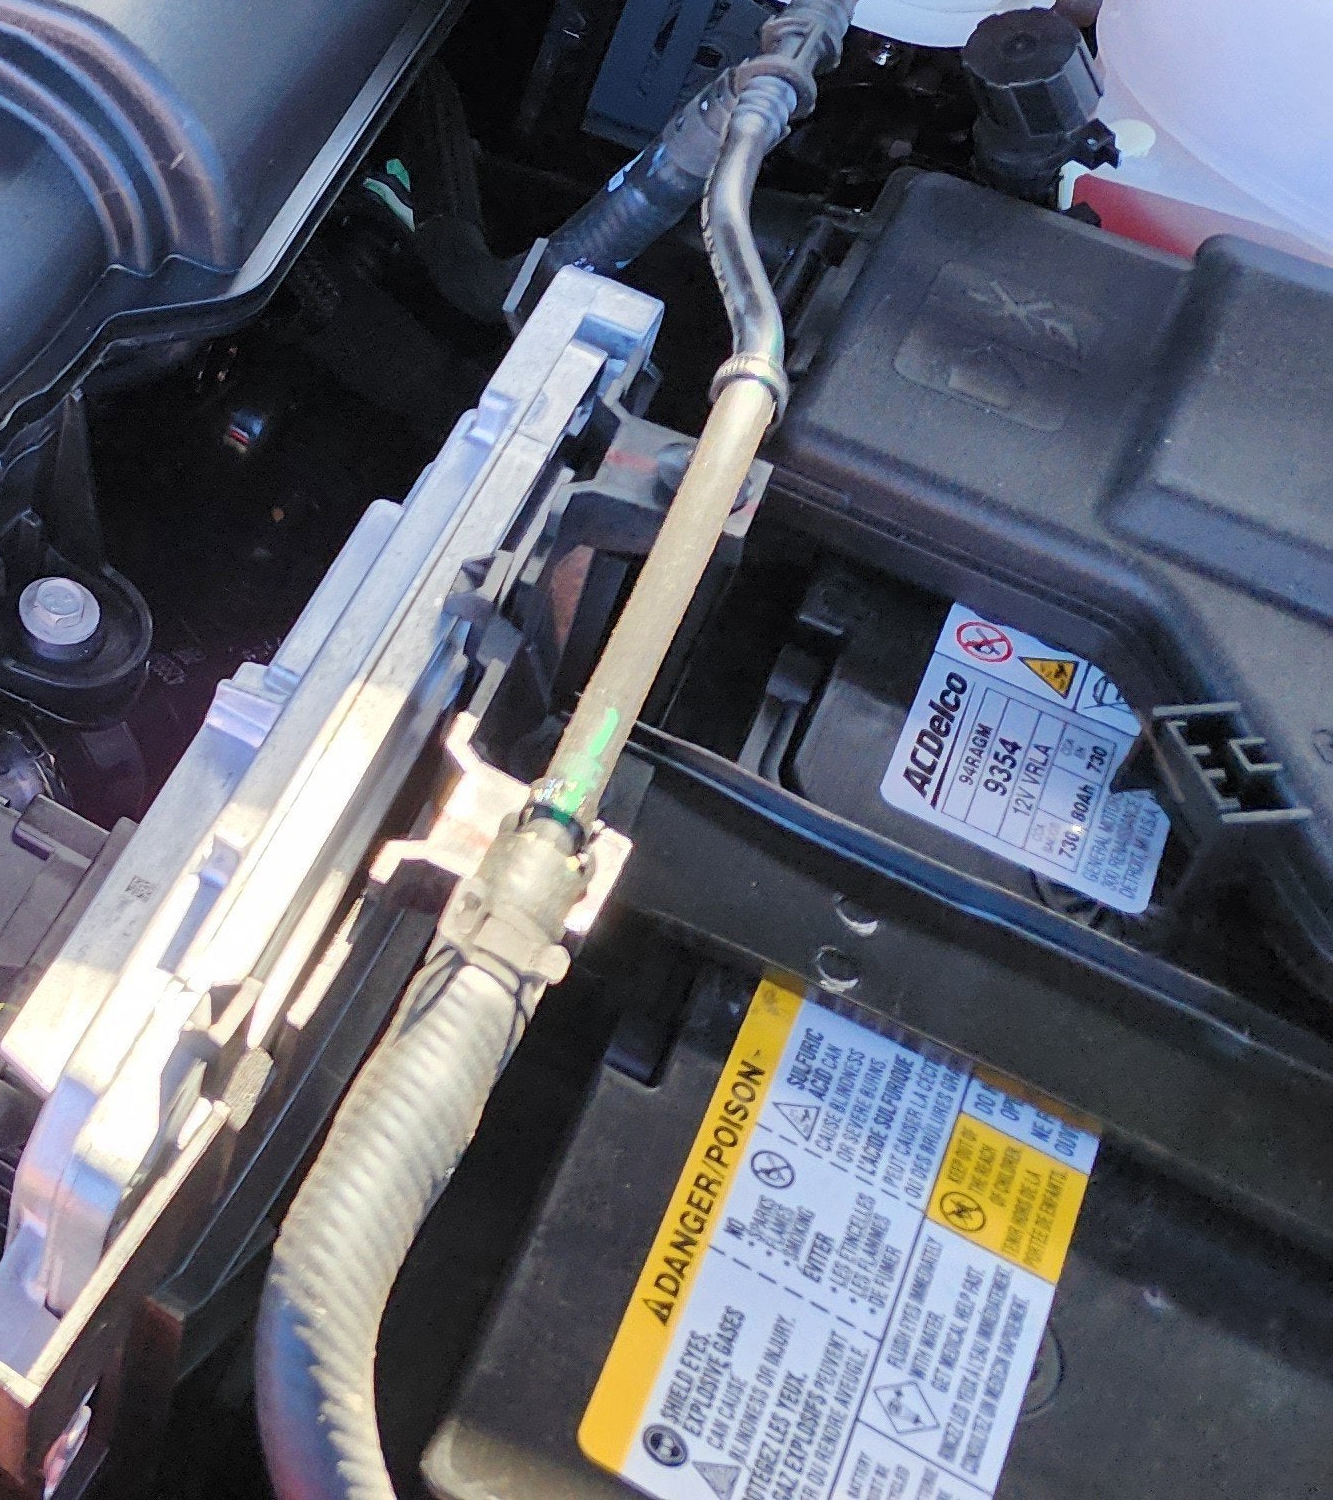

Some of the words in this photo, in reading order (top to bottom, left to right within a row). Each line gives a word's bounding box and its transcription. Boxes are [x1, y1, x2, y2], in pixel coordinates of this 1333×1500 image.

[903, 671, 968, 799] ACDelco
[958, 722, 994, 786] 94RAGM
[983, 737, 1023, 797] 9354
[1023, 744, 1054, 785] VRLA
[1086, 745, 1107, 774] 730
[1012, 784, 1038, 816] 12V
[1058, 830, 1080, 861] 730
[787, 1028, 823, 1090] SULFURIC
[808, 1068, 833, 1101] ACID
[821, 1043, 842, 1070] CAN
[815, 1111, 843, 1151] CAUSE
[829, 1048, 865, 1114] BLINDNESS
[874, 1054, 914, 1130] SULFURIQUE
[843, 1097, 872, 1142] SEVERE
[894, 1107, 923, 1156] CAUSER
[836, 1142, 855, 1163] OR
[883, 1154, 907, 1189] PEUT
[911, 1153, 932, 1180] DES
[655, 1059, 767, 1299] DANGER/POISON
[725, 1218, 746, 1240] NO
[747, 1195, 776, 1241] SPARKS
[765, 1204, 794, 1251] FLAMES
[782, 1207, 814, 1261] SMOKING
[858, 1213, 890, 1273] FLAMMES
[830, 1261, 852, 1288] LES
[849, 1272, 871, 1299] LES
[661, 1370, 693, 1424] SHIELD
[680, 1331, 711, 1372] EYES.
[684, 1353, 728, 1437] EXPLOSIVE
[714, 1306, 744, 1356] GASES
[776, 1371, 807, 1412] YEUX.
[718, 1372, 747, 1420] CAUSE
[729, 1386, 768, 1464] BLINDNESS
[756, 1365, 775, 1387] OR
[783, 1391, 826, 1474] EXPLOSIFS
[814, 1330, 846, 1393] PEUVENT
[707, 1419, 730, 1450] CAN
[766, 1412, 790, 1444] LES
